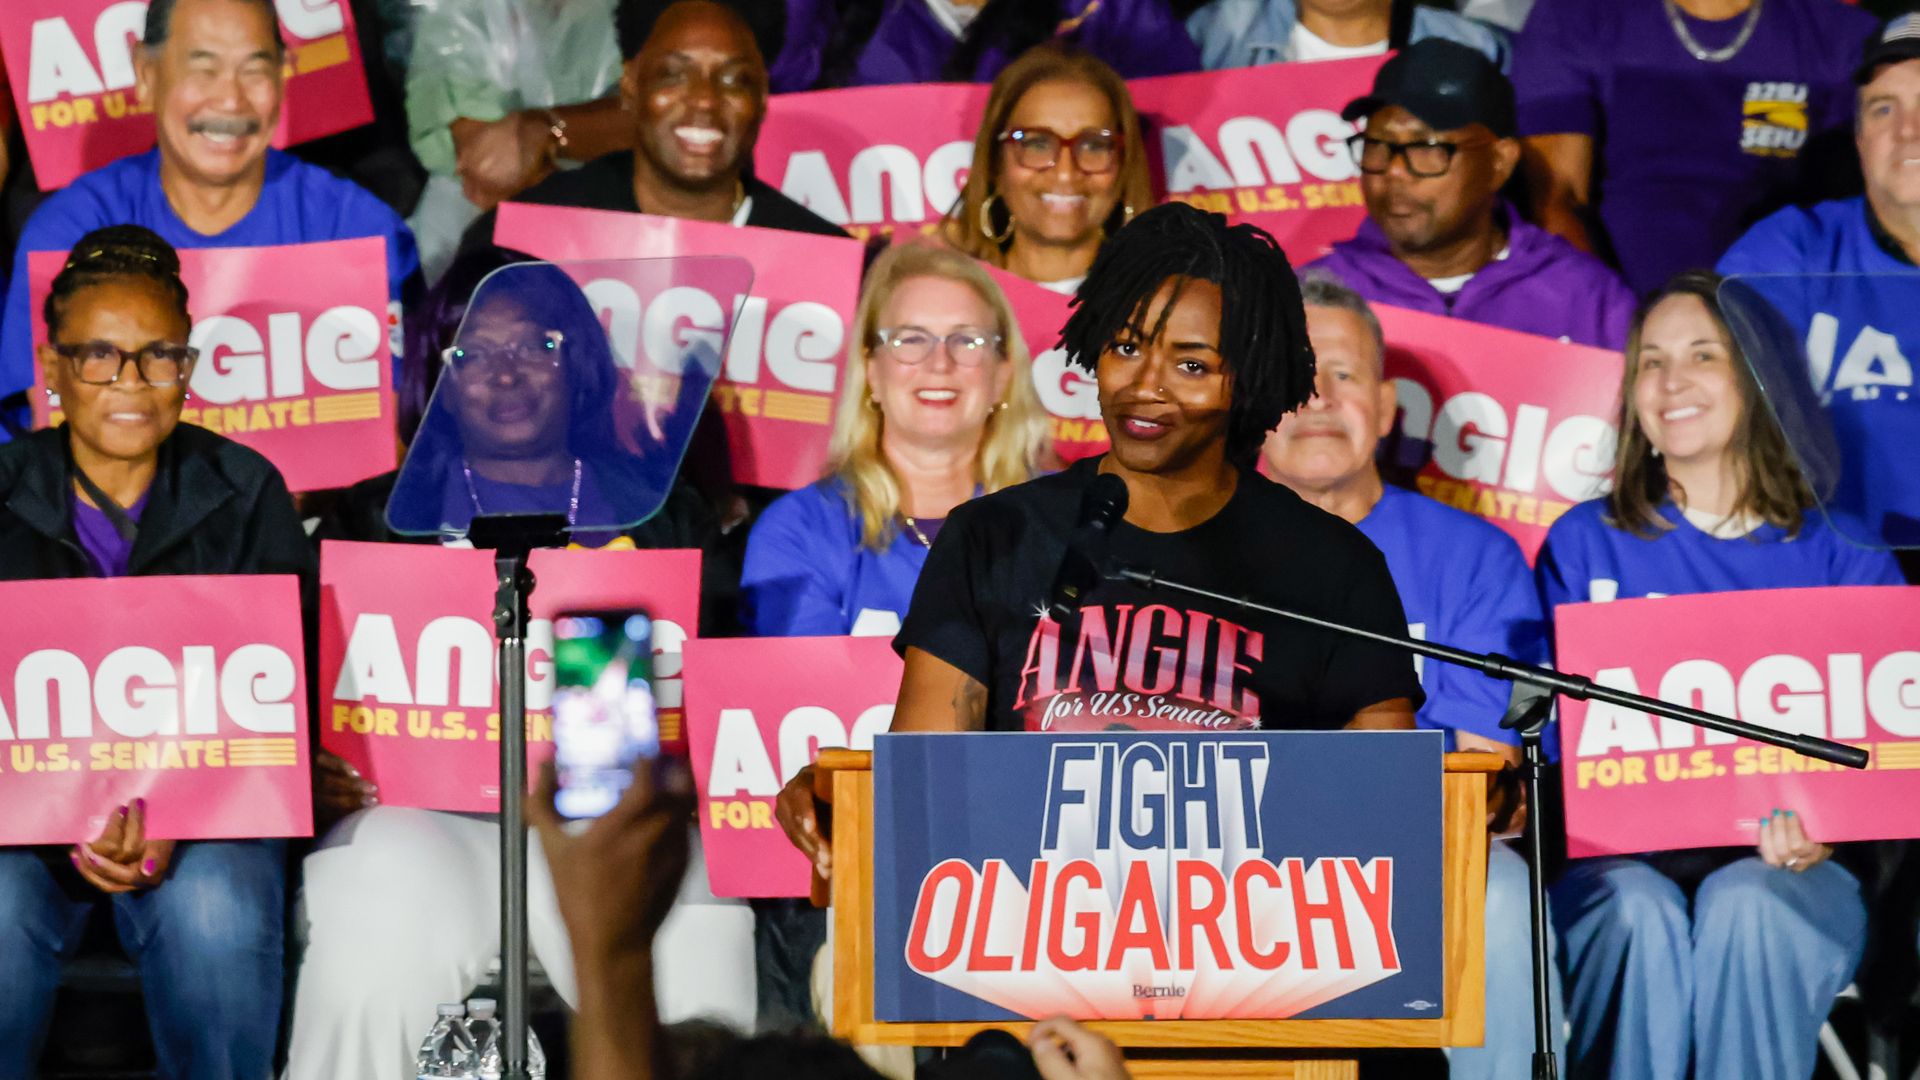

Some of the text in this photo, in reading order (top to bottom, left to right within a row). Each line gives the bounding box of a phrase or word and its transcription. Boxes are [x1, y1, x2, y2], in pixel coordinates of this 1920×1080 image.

[31, 98, 98, 131] FOR
[1162, 110, 1367, 192] ANG
[1238, 187, 1299, 213] U.S.
[1301, 181, 1364, 209] SEN
[187, 305, 381, 405] GIE
[578, 278, 844, 393] NGIE
[1012, 604, 1264, 722] ANGIE
[0, 643, 296, 740] NGIE
[332, 704, 399, 737] FOR
[407, 709, 478, 741] U.S.
[1040, 692, 1084, 731] for
[1137, 695, 1232, 730] Senate
[11, 744, 81, 773] U.S.
[90, 740, 226, 771] SENATE
[1577, 759, 1647, 789] FOR
[1655, 750, 1727, 782] U.S.
[709, 801, 773, 829] FOR
[1042, 742, 1269, 853] FIGHT
[905, 859, 1400, 972] OLIGARCHY
[1132, 984, 1185, 998] Bernie
